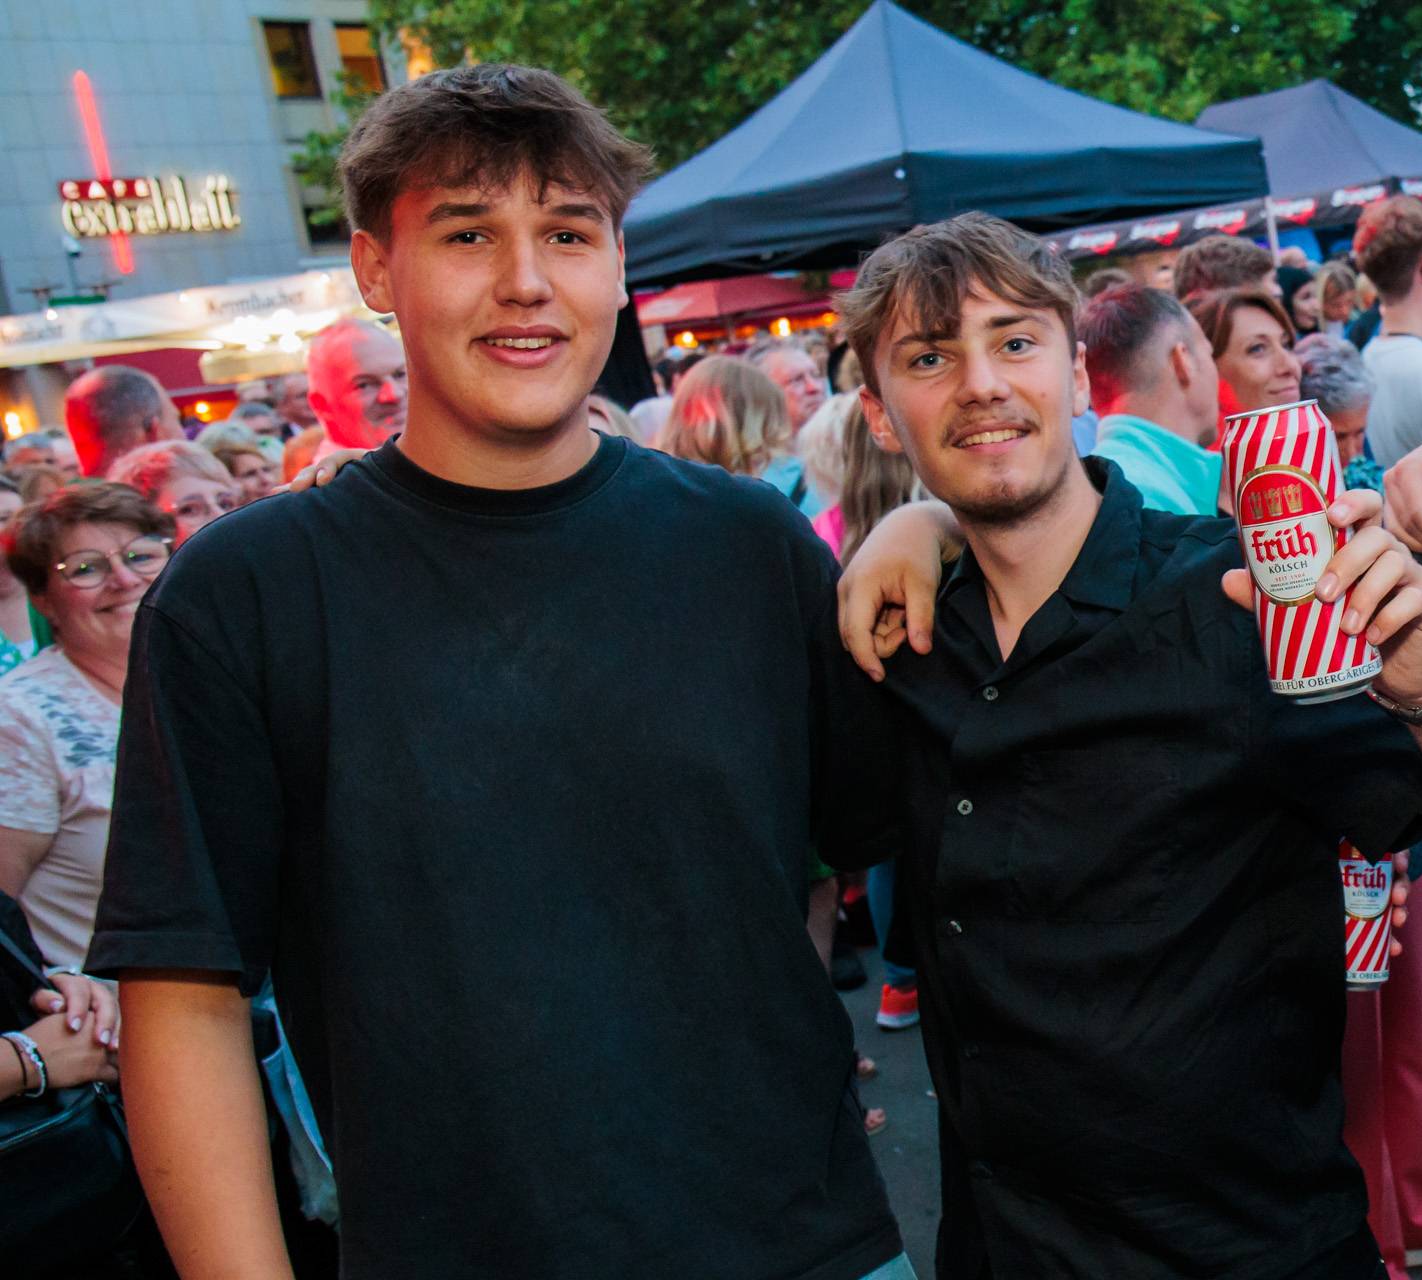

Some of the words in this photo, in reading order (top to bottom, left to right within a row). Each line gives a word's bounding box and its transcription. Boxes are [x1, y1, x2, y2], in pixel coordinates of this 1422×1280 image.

[1251, 521, 1319, 563] früh
[1268, 560, 1308, 574] KÖLSCH
[1287, 679, 1305, 690] FÜR
[1342, 864, 1387, 891] früh
